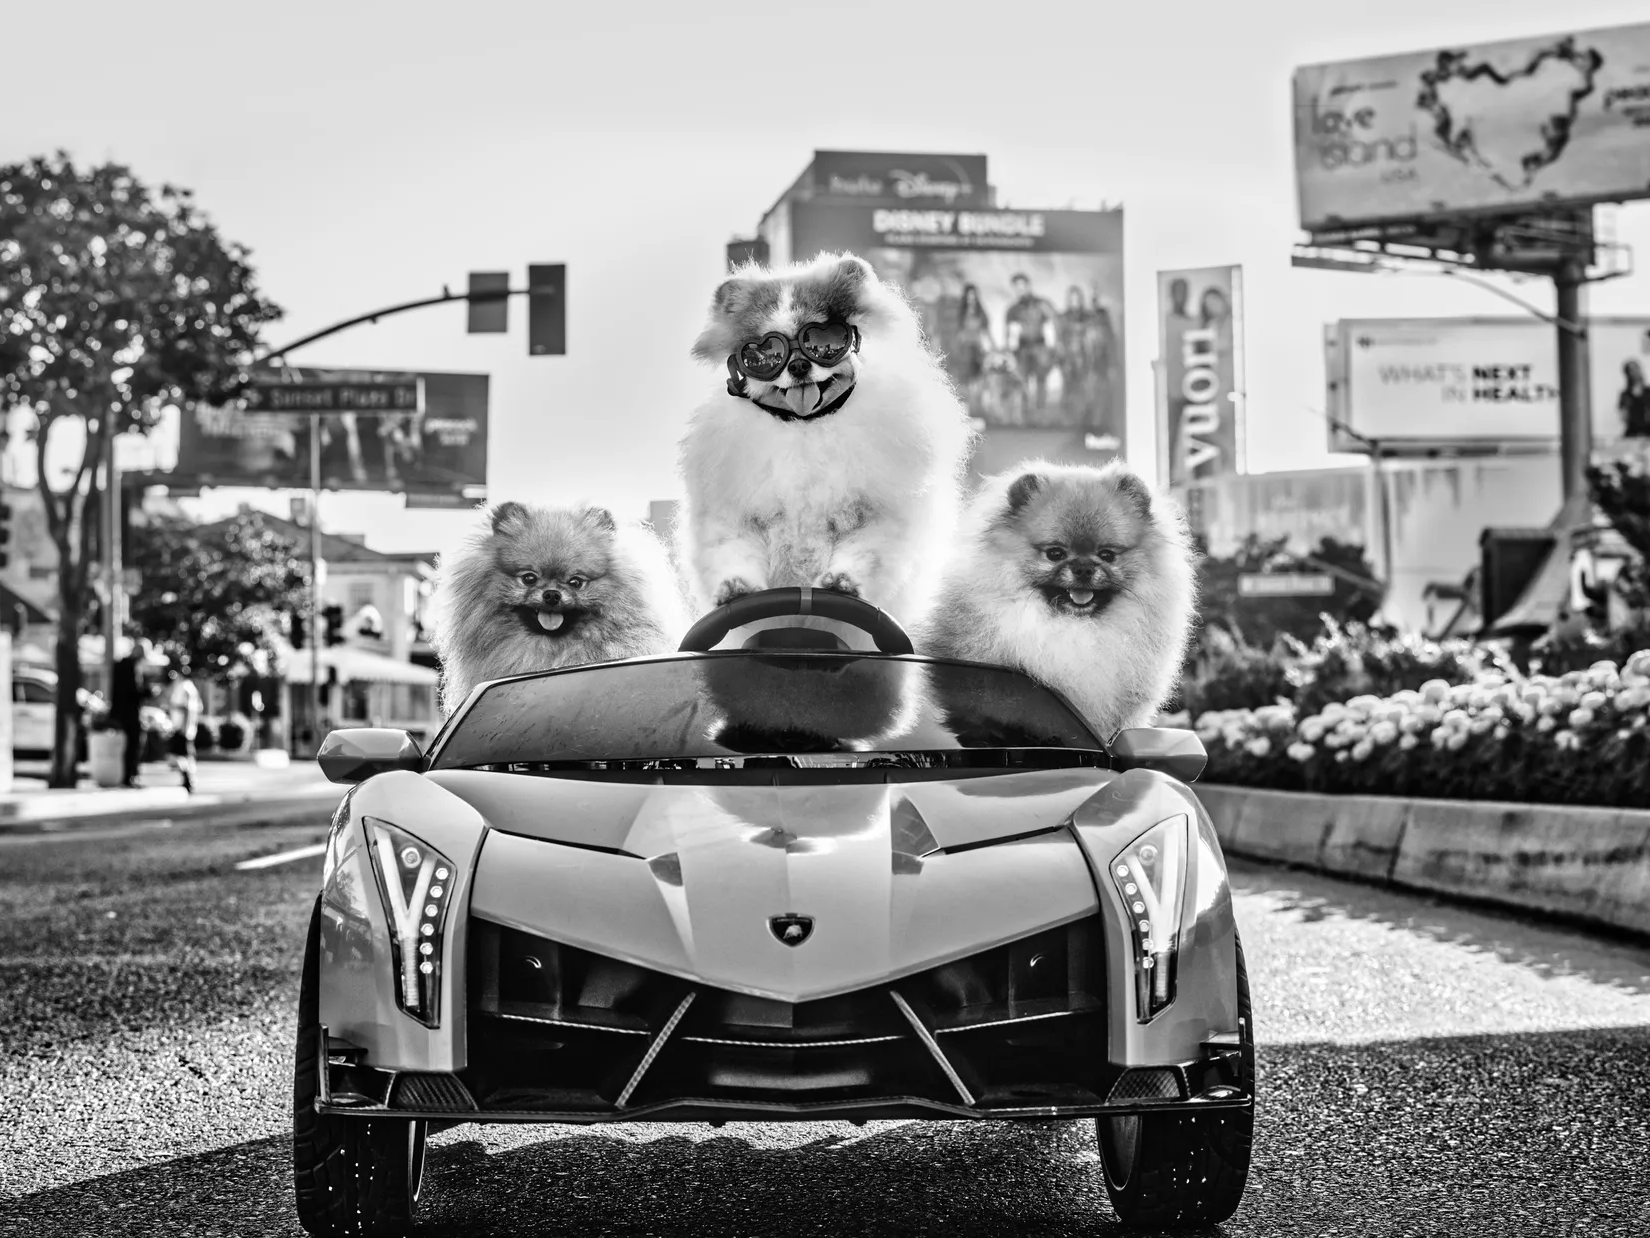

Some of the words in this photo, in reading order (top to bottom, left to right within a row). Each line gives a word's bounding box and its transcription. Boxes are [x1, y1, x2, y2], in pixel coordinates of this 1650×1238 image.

[872, 209, 955, 233] DISNEY
[957, 212, 1045, 237] BUNDLE
[1377, 364, 1467, 385] WHAT'S
[1472, 363, 1533, 381] NEXT
[1441, 384, 1467, 404] IN
